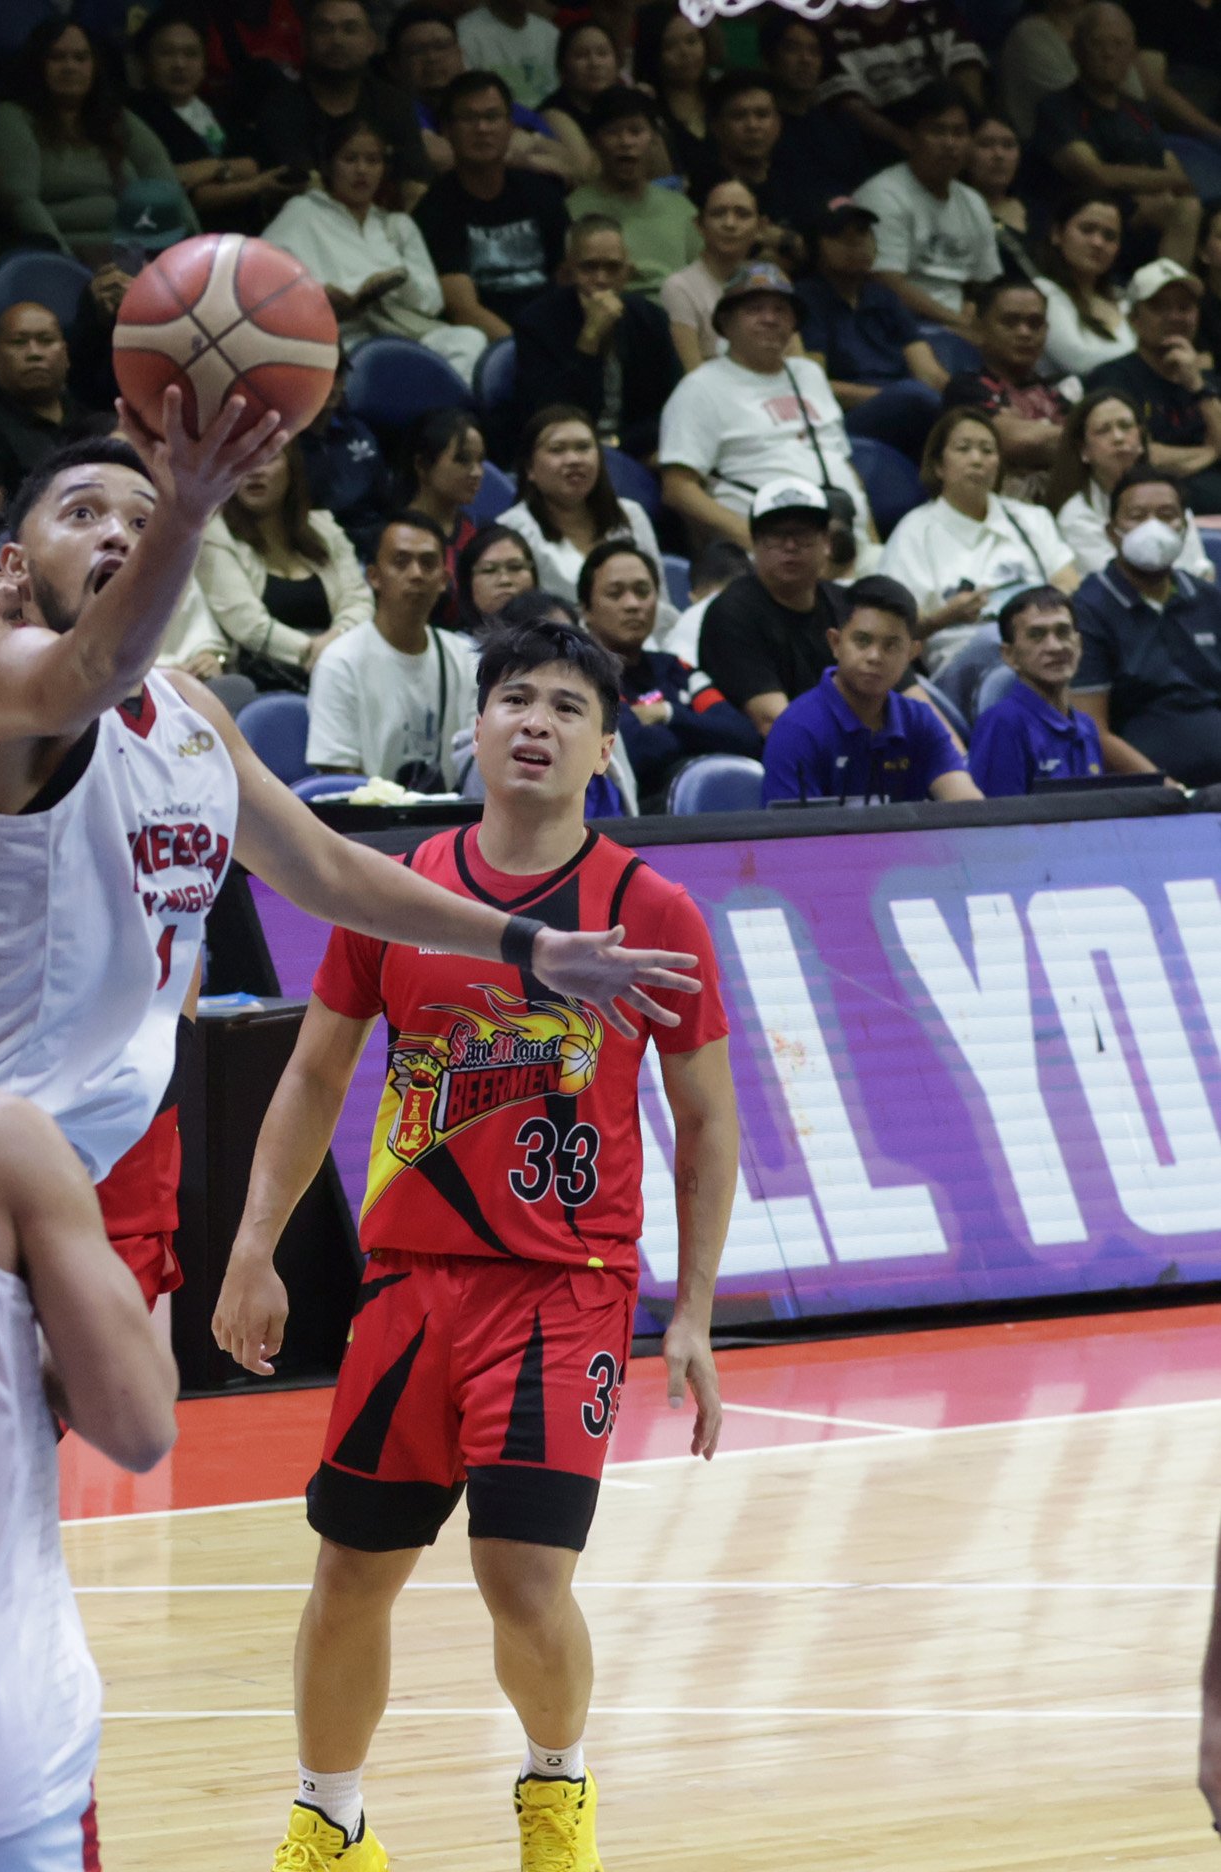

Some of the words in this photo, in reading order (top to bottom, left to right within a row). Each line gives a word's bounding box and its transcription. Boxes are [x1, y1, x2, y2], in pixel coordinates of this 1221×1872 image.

[448, 1022, 488, 1067] San
[488, 1032, 562, 1066] Miguel
[445, 1061, 564, 1127] BEERMEN
[508, 1117, 599, 1207] 33
